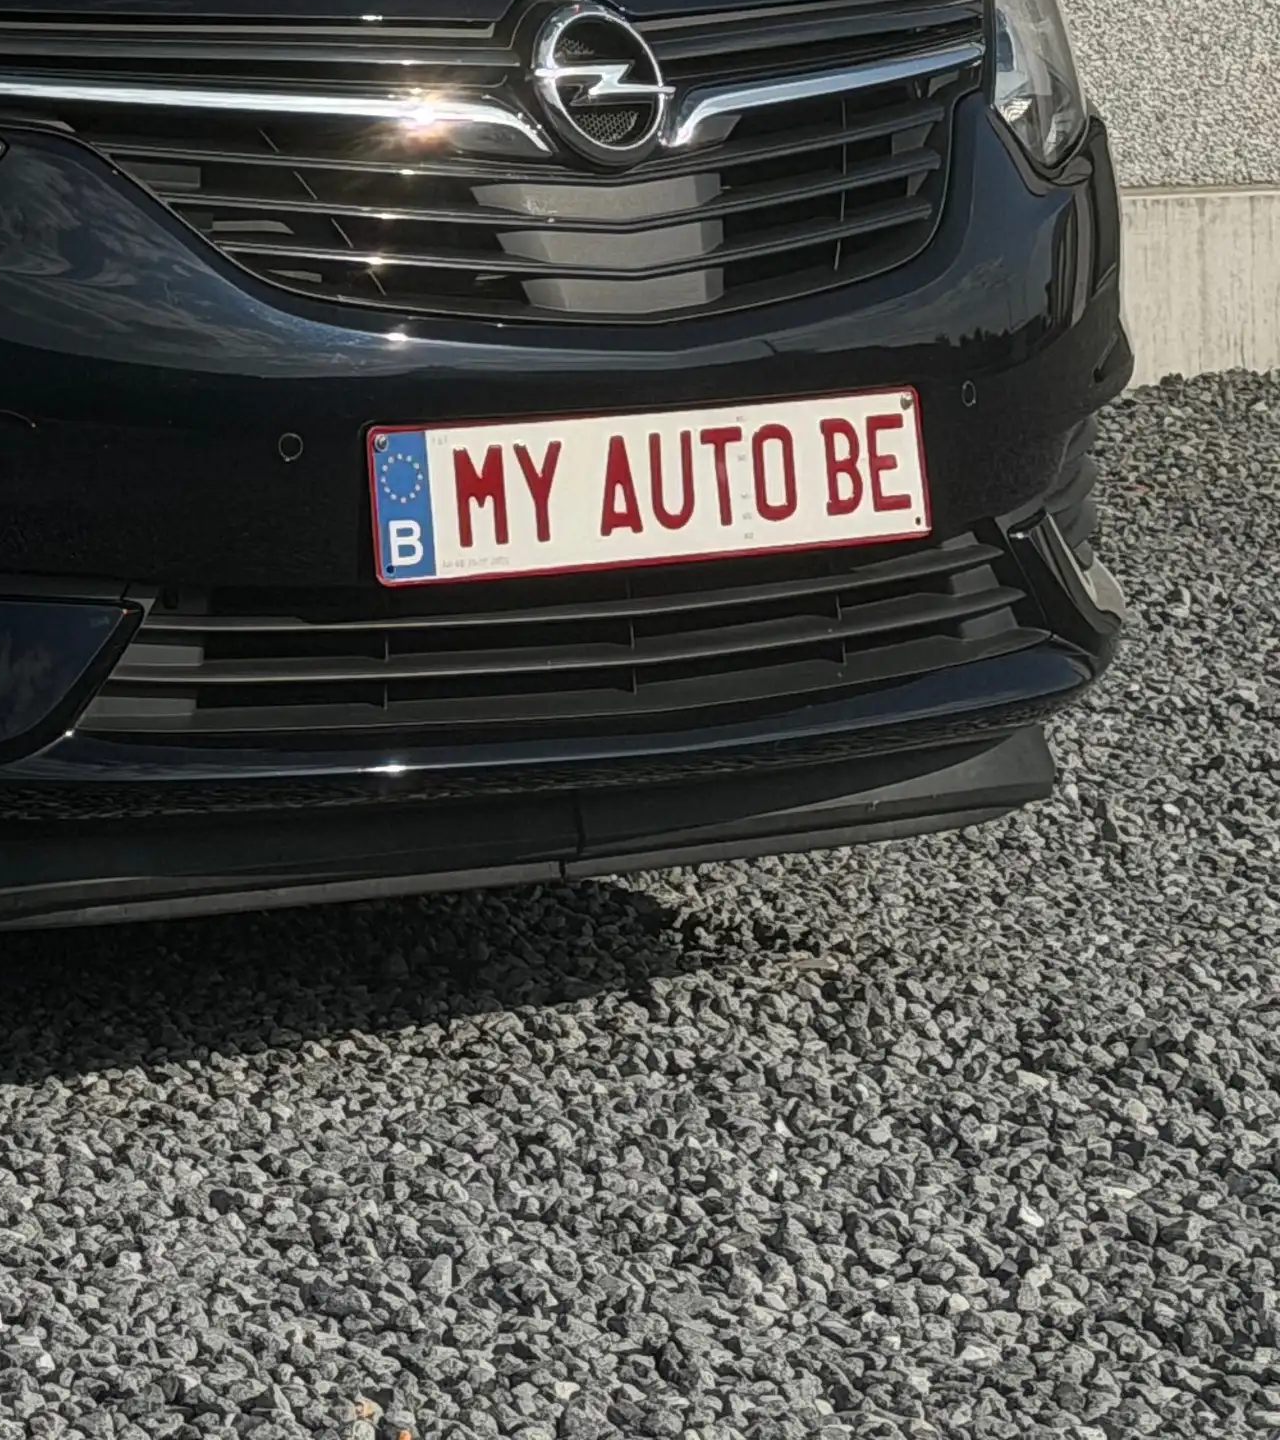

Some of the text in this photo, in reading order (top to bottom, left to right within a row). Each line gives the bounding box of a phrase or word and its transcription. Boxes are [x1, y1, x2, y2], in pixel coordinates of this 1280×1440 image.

[453, 413, 913, 548] MY AUTO BE
[388, 520, 424, 567] B
